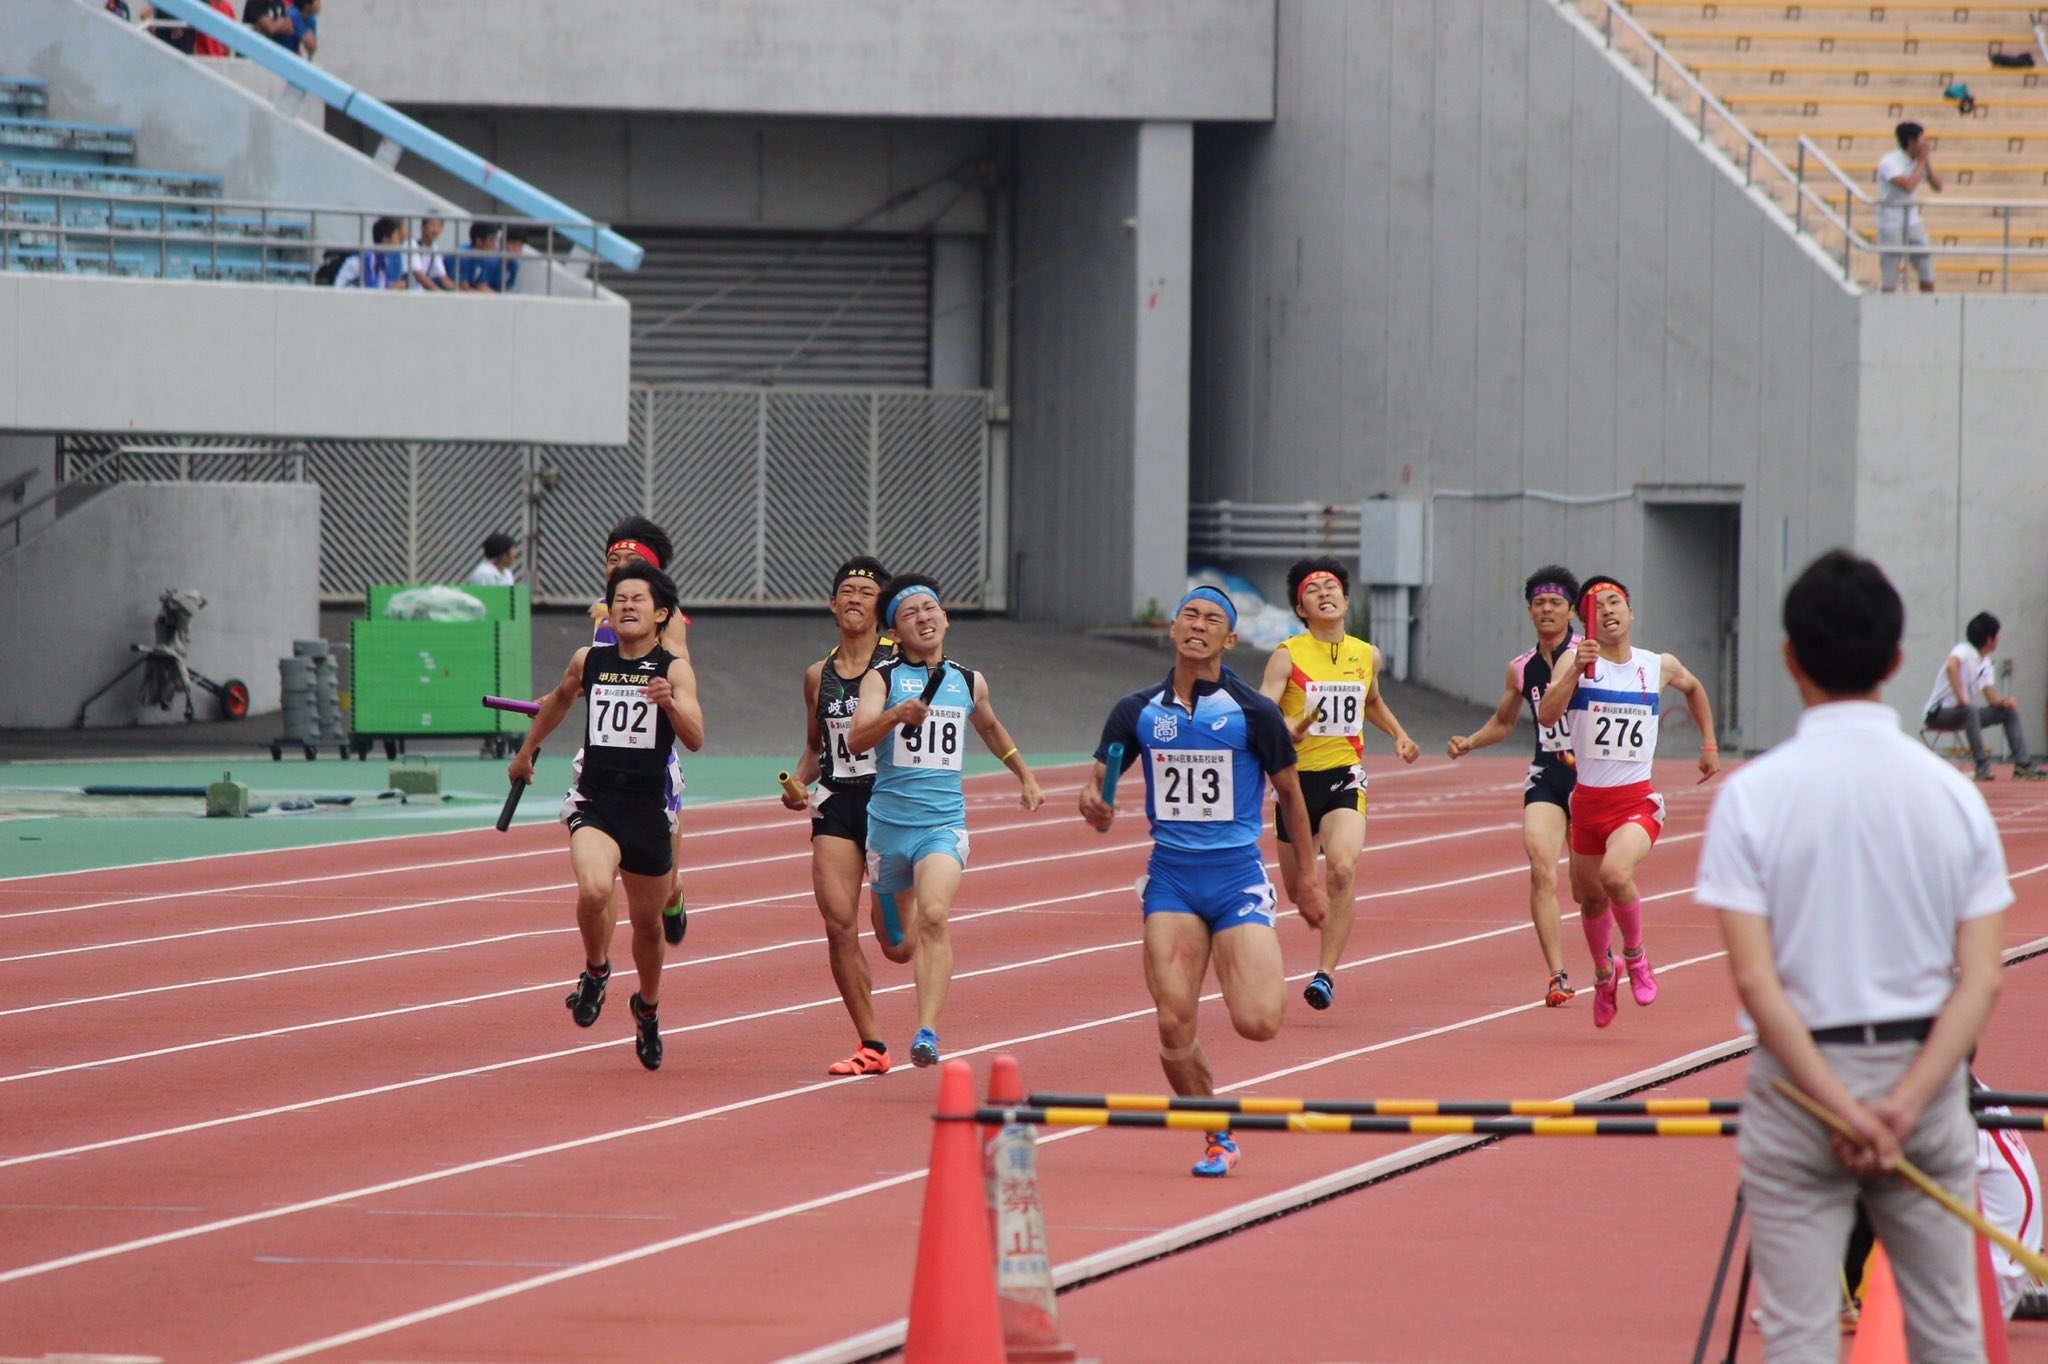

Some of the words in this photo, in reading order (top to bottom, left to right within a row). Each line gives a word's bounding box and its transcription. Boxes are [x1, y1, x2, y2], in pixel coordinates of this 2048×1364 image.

[596, 700, 648, 733] 702
[1315, 696, 1357, 723] 618
[1594, 716, 1643, 748] 276
[1164, 767, 1221, 804] 213
